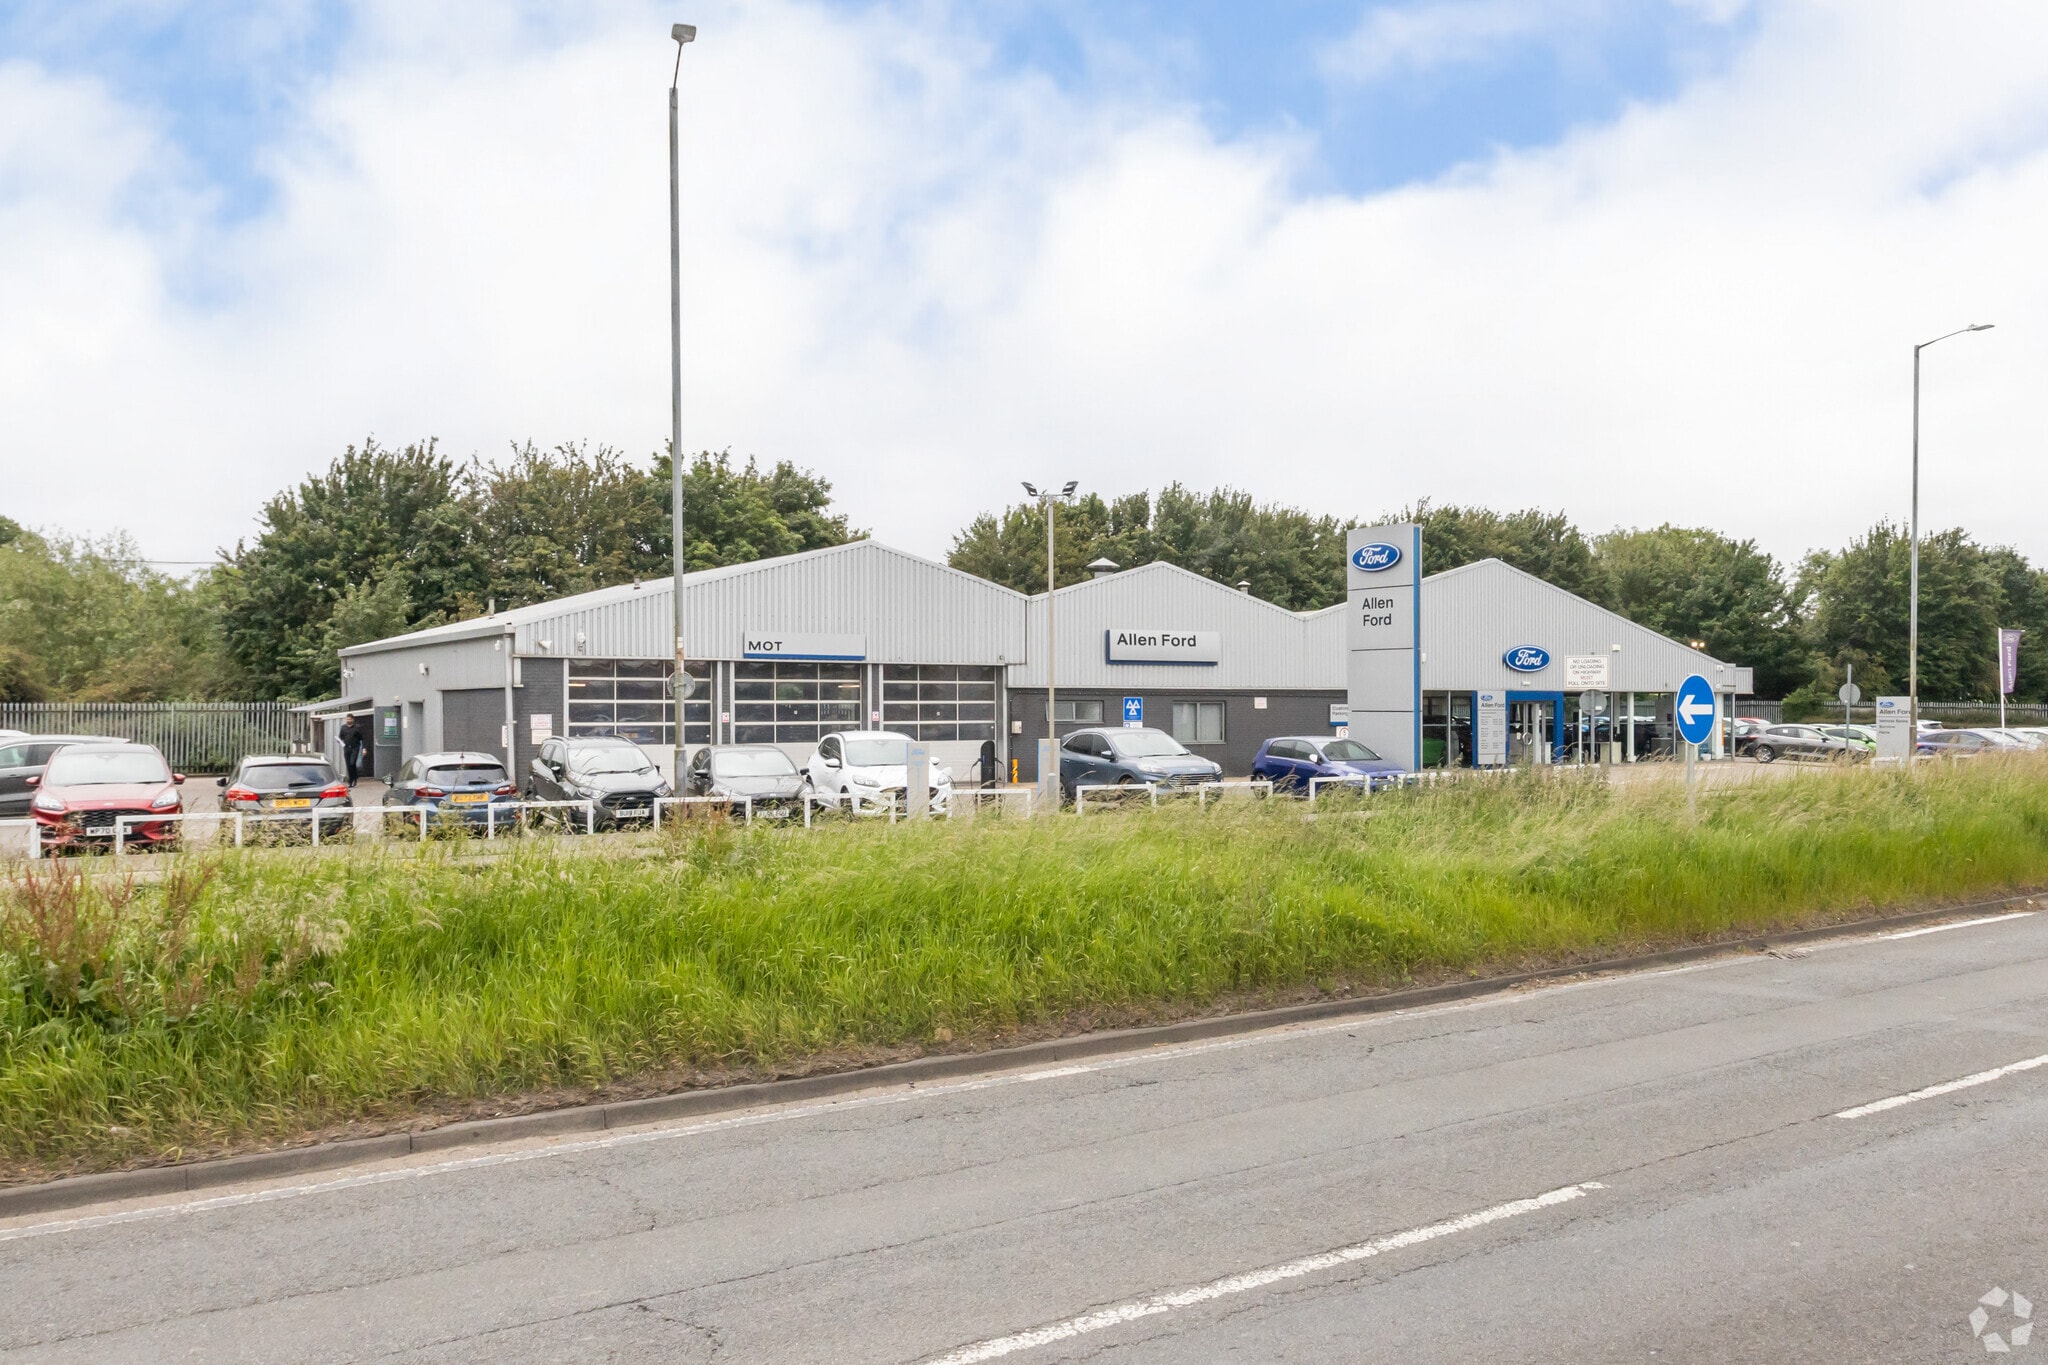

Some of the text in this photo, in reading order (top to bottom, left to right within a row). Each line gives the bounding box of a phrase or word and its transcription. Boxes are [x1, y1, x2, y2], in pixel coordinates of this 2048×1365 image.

[1359, 547, 1389, 566] Ford
[1362, 597, 1394, 610] Allen
[1363, 613, 1392, 627] Ford
[748, 641, 783, 651] MOT
[1117, 633, 1197, 647] Allen Ford
[1515, 649, 1544, 666] Ford
